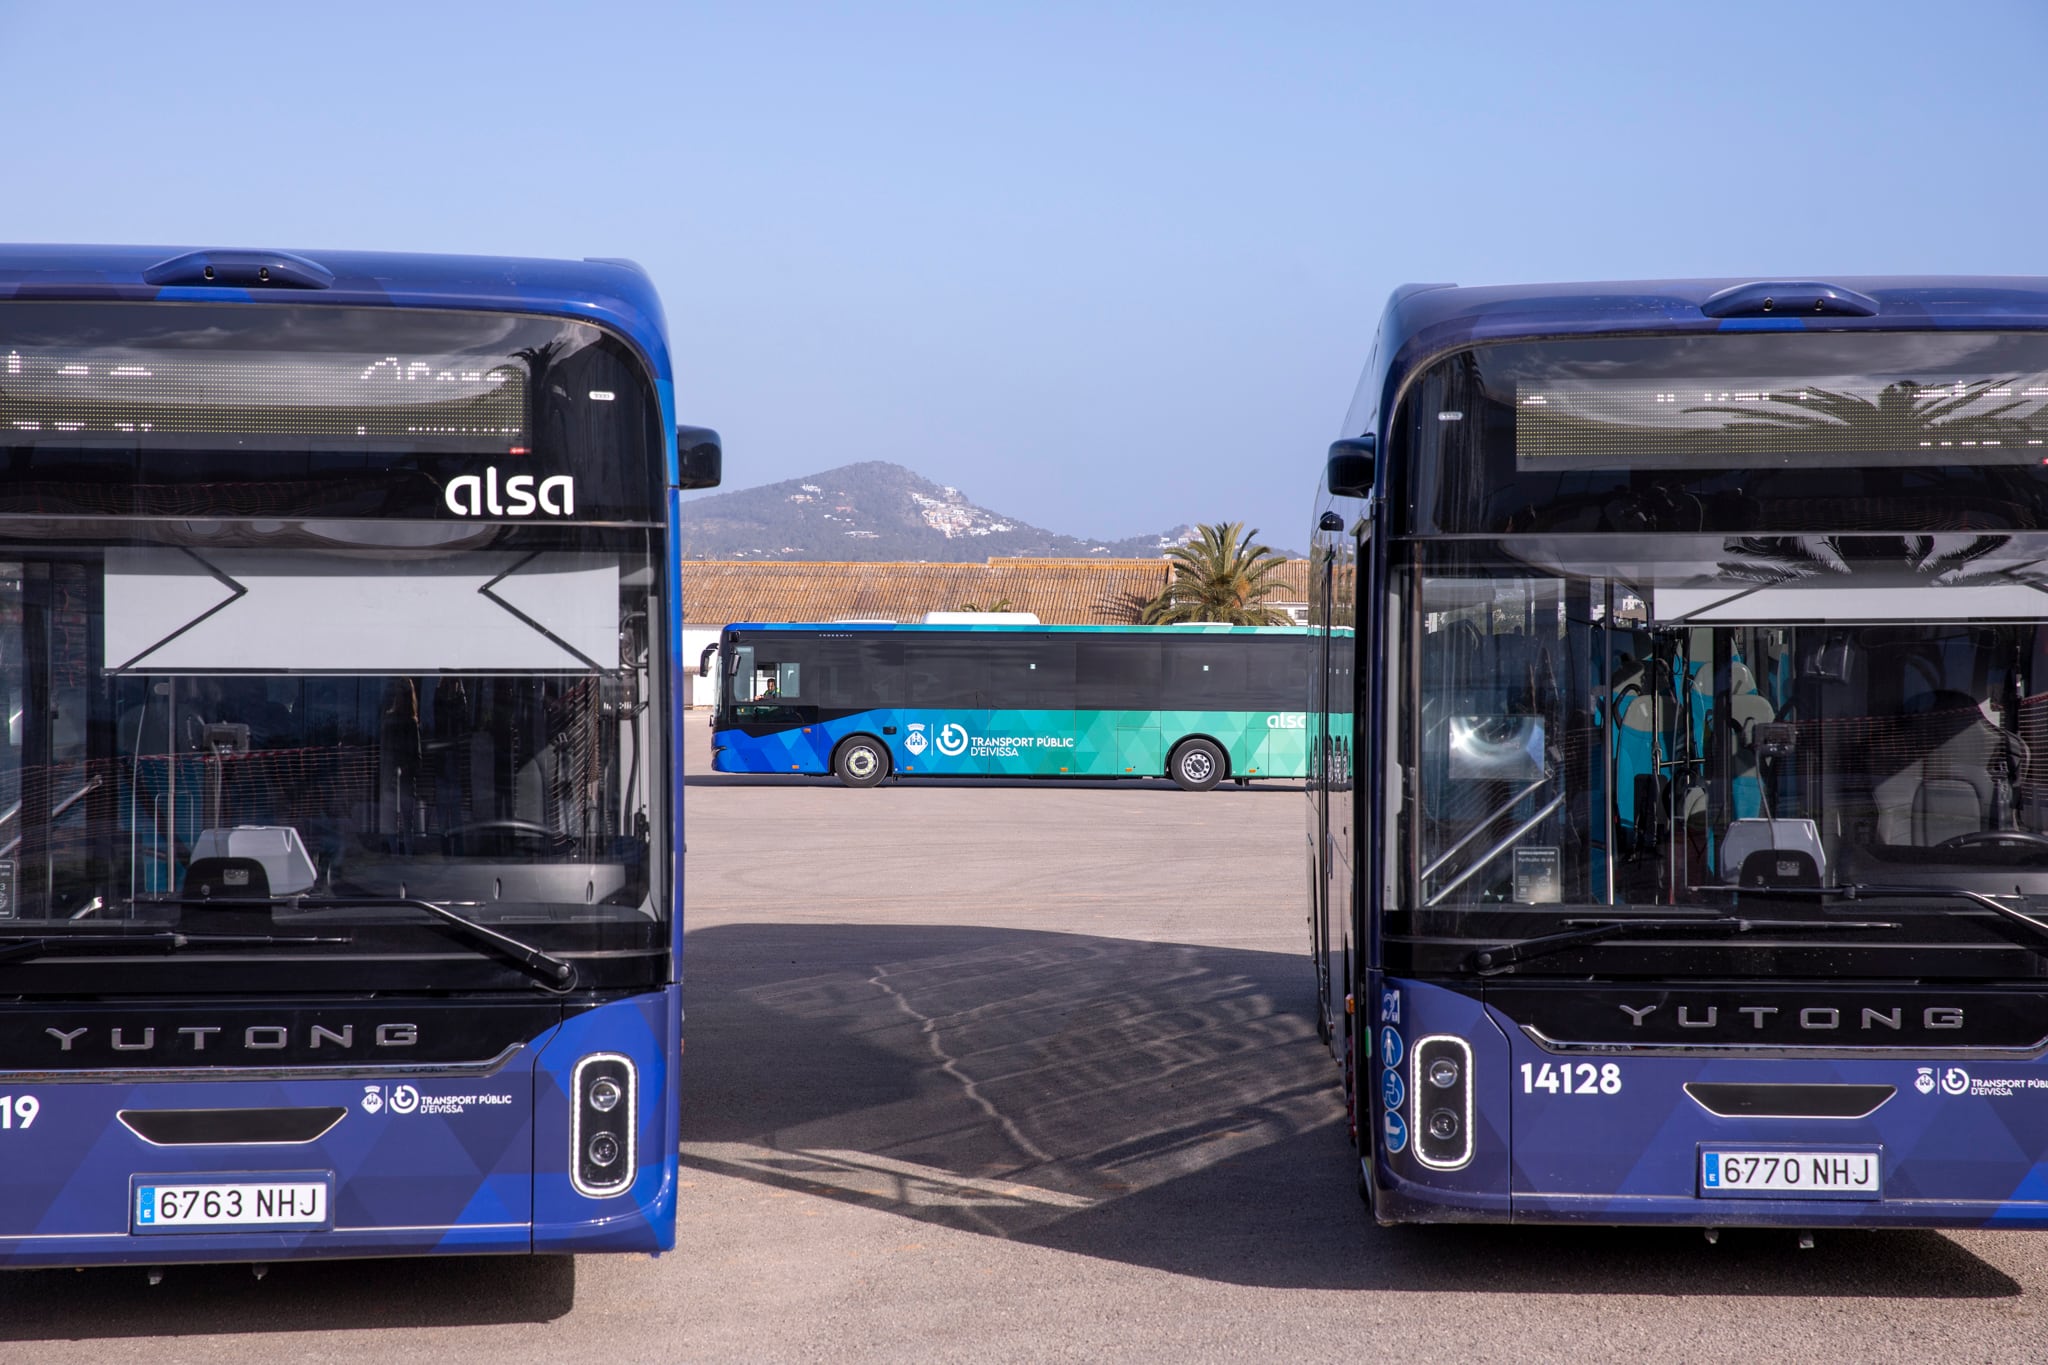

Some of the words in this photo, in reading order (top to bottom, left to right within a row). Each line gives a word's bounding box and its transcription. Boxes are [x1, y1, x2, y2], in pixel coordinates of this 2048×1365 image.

[445, 466, 574, 516] alsa
[971, 737, 1034, 748] TRANSPORT
[1037, 735, 1074, 748] PÚBLIC
[970, 748, 1019, 757] D'EIVISSA
[1619, 1004, 1964, 1030] YUTONG
[45, 1023, 418, 1051] YUTONG
[1520, 1062, 1622, 1095] 14128
[1970, 1079, 2026, 1088] TRANSPORT
[421, 1095, 476, 1105] TRANSPORT
[479, 1093, 512, 1105] PÚBLIC
[1971, 1088, 2013, 1096] D'EIVISSA
[420, 1105, 464, 1114] D'EIVISSA
[1725, 1158, 1800, 1184] 6770
[1813, 1159, 1869, 1185] NHJ
[144, 1209, 152, 1218] E
[161, 1190, 243, 1219] 6763
[256, 1188, 316, 1218] NHJ
